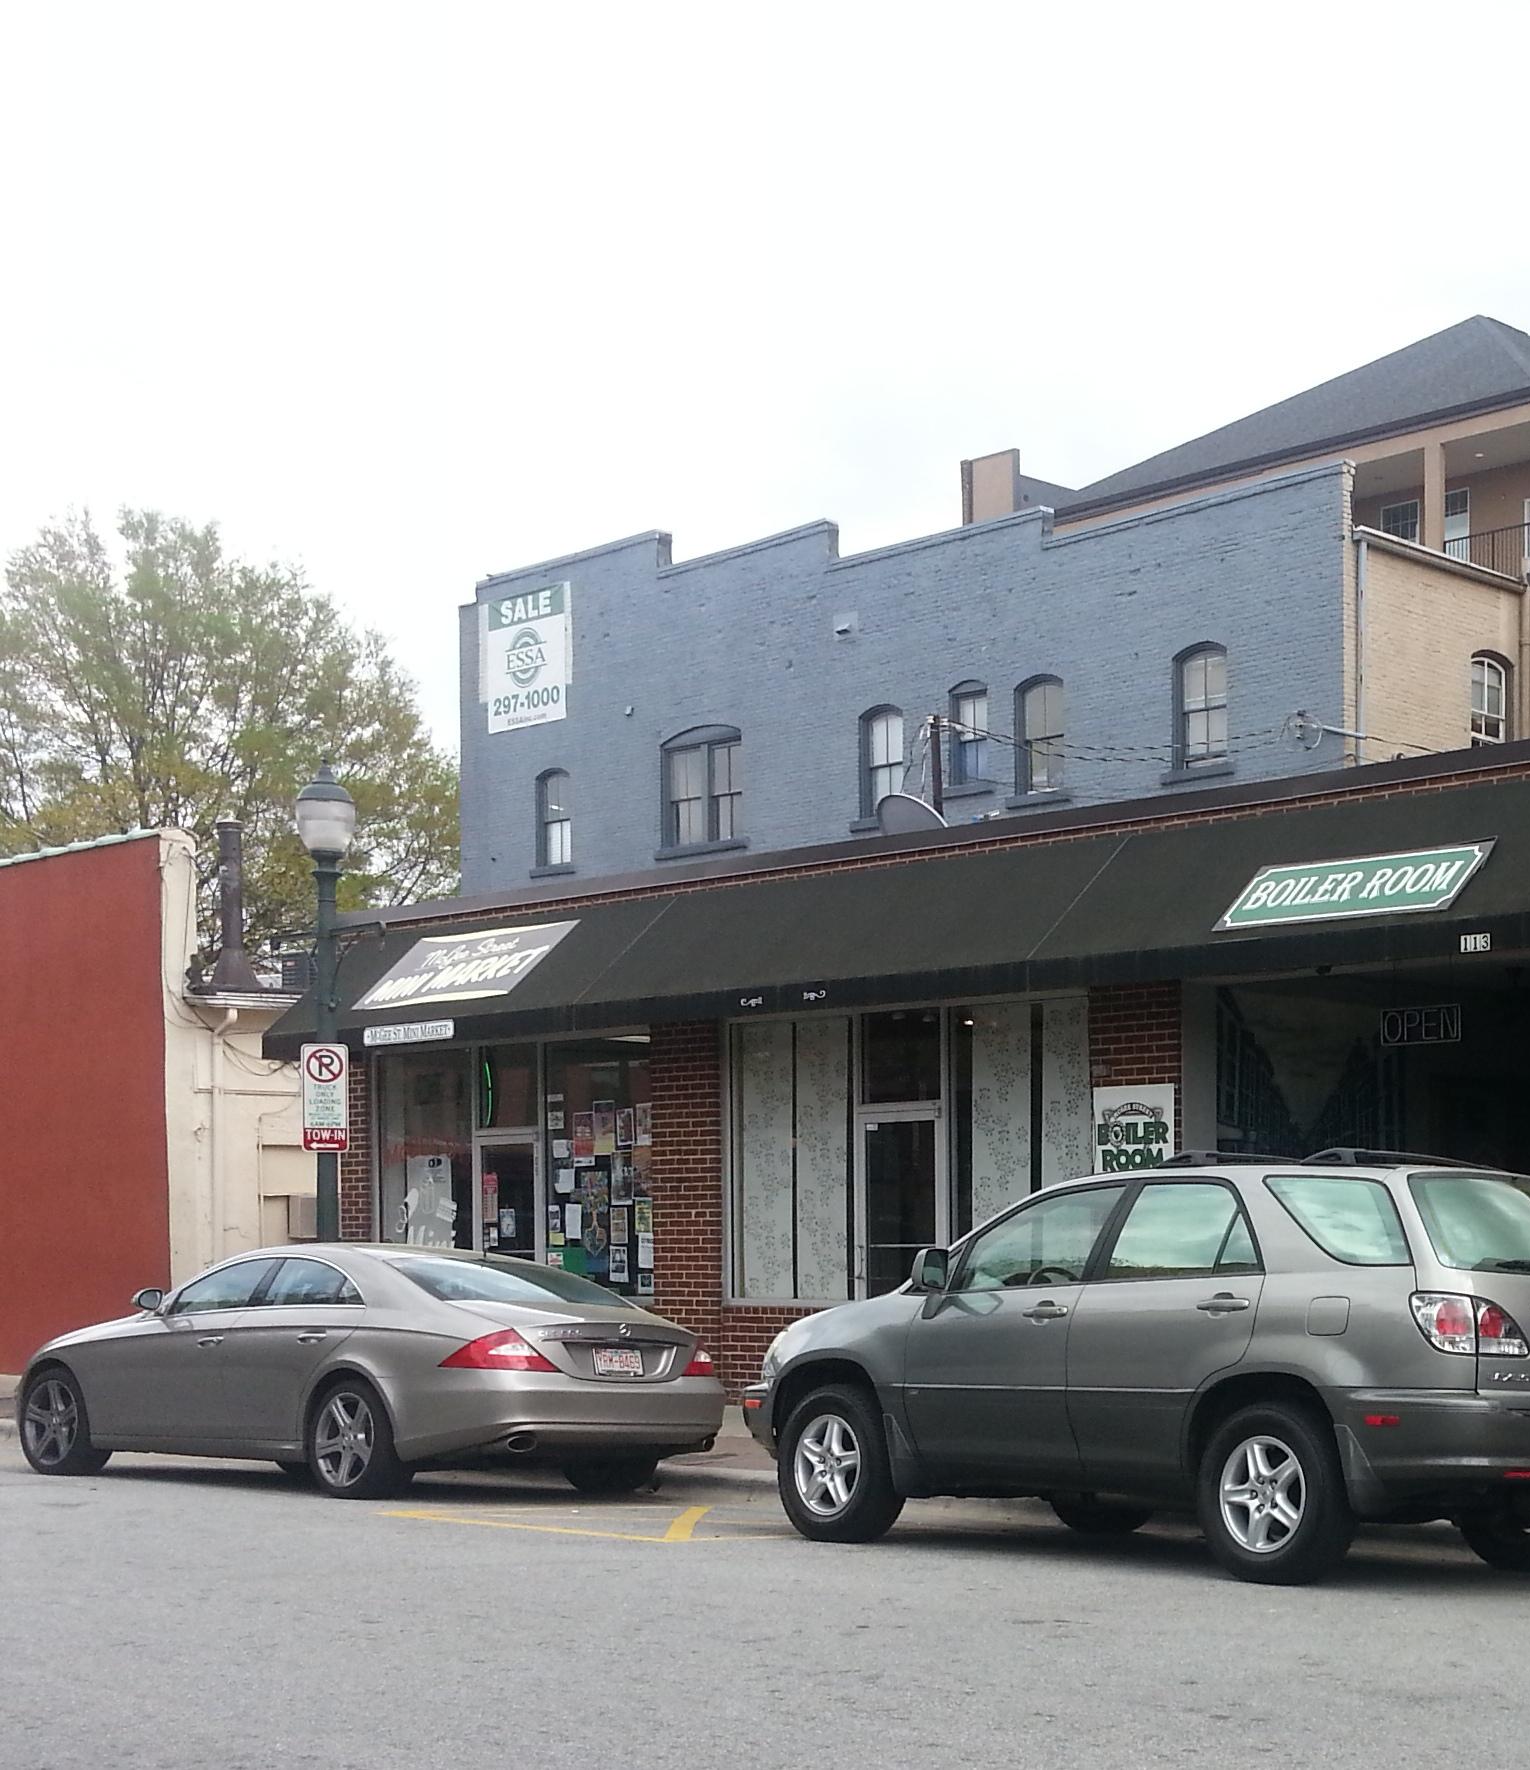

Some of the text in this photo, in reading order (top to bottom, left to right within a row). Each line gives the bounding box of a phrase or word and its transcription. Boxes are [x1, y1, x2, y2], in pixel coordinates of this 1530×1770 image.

[501, 590, 551, 625] SALE
[507, 647, 546, 671] ESSA
[494, 685, 560, 717] 297-1000
[1241, 860, 1465, 911] BOILER ROOM
[472, 937, 520, 957] Street
[1462, 935, 1489, 951] 113
[364, 945, 551, 1004] MINI MARKET
[1384, 1007, 1457, 1042] OPEN
[305, 1129, 346, 1140] TOW-IN
[1097, 1121, 1169, 1146] BOILER
[1102, 1148, 1163, 1171] ROOM
